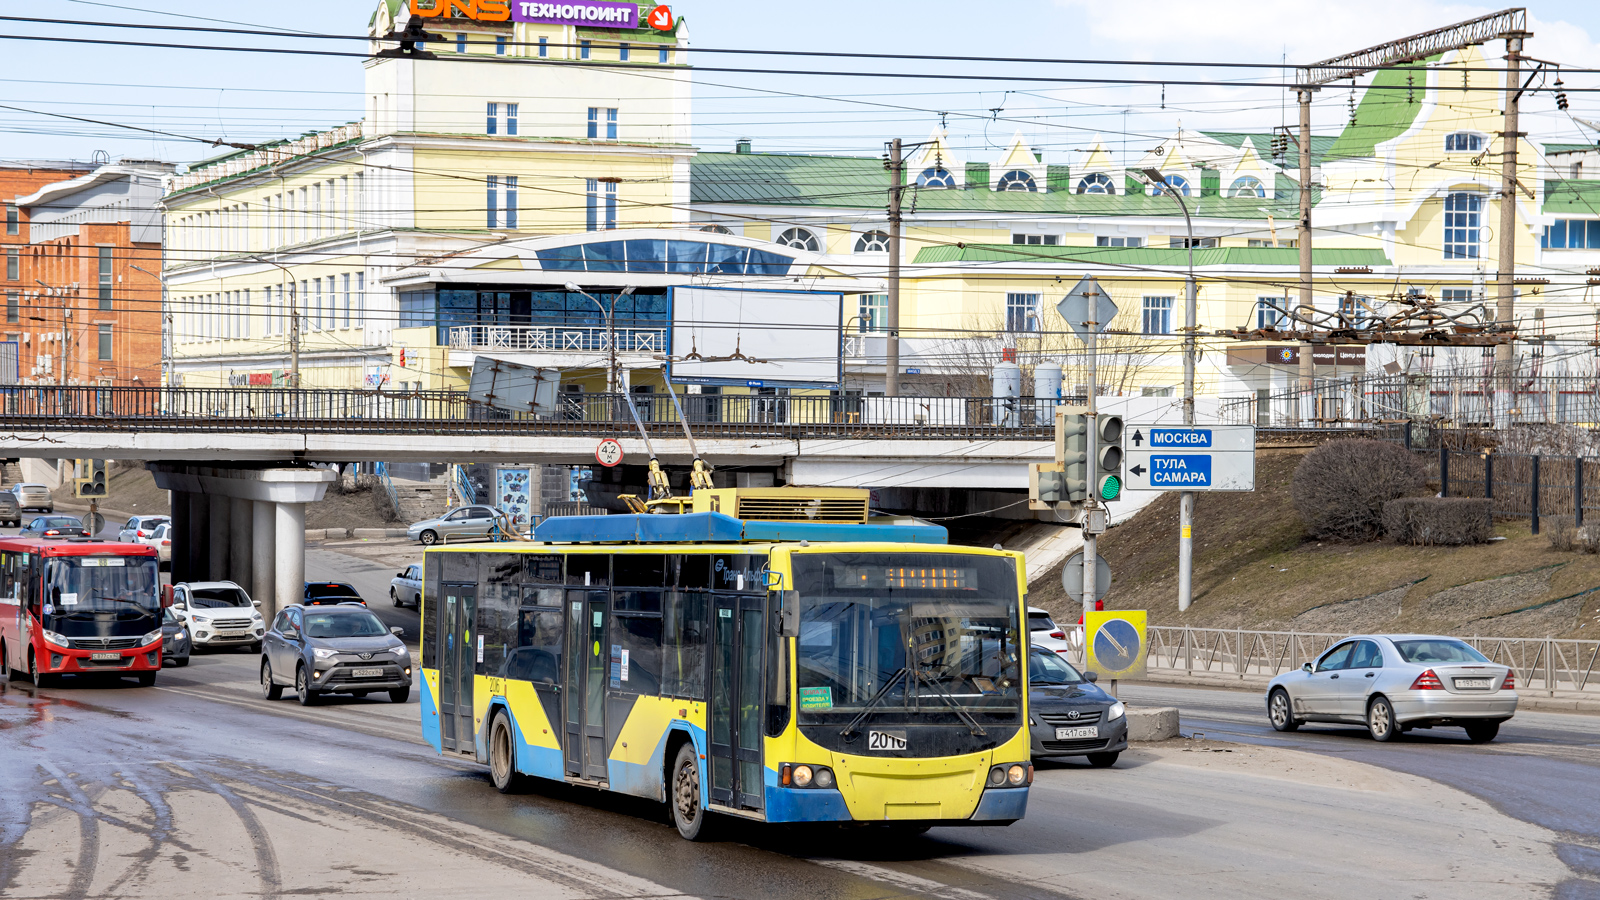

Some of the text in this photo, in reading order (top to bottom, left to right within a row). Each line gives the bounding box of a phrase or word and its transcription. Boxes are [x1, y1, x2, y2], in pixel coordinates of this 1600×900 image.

[410, 0, 510, 21] DNS
[519, 2, 631, 22] ТЕХНОПОИНТ
[1154, 433, 1207, 443] МОСКВА
[601, 445, 616, 454] 4.2
[1154, 459, 1187, 469] ТУЛА
[1154, 472, 1206, 482] САМАРА
